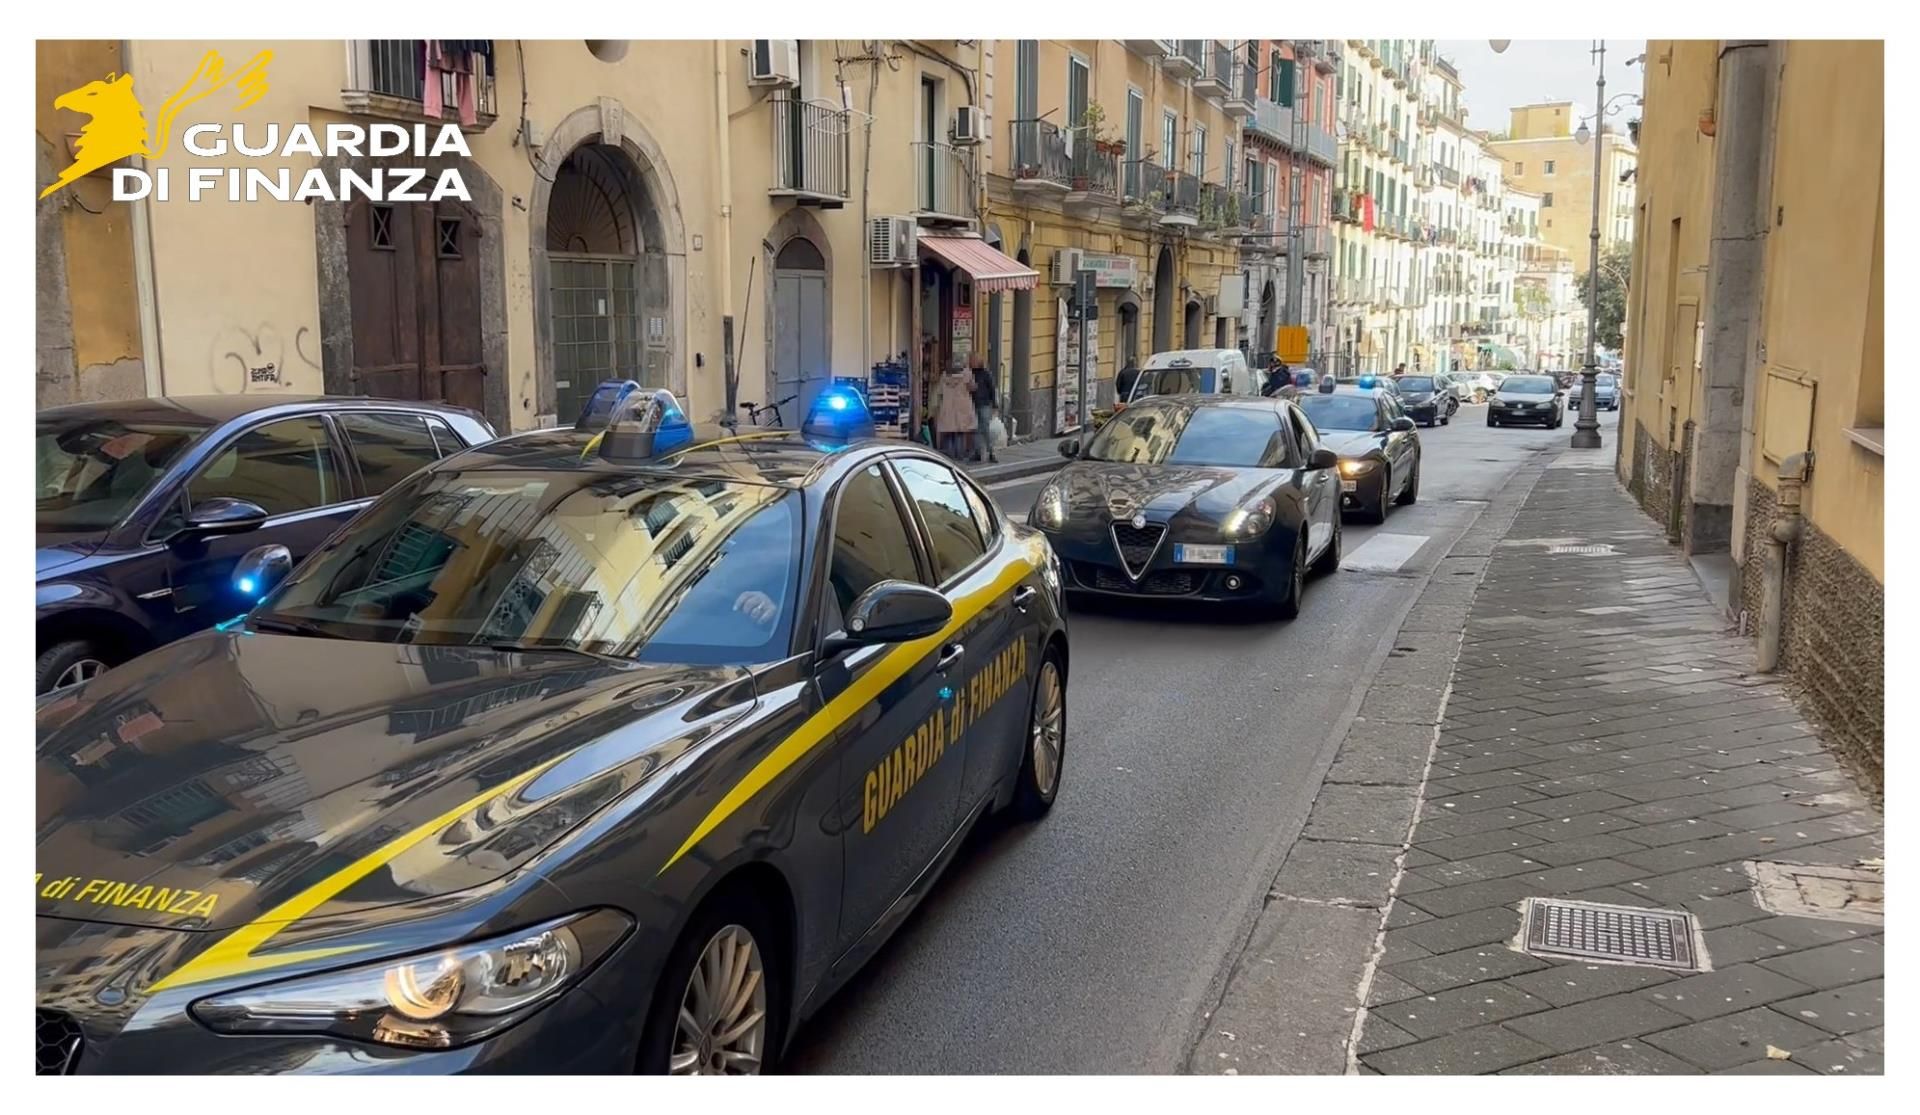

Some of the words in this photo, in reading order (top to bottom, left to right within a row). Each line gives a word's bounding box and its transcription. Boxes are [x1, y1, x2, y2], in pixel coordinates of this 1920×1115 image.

[864, 707, 945, 835] GUARDIA
[950, 687, 965, 745] di
[969, 635, 1026, 727] FINANZA
[40, 876, 81, 900] di
[74, 879, 219, 918] FINANZA
